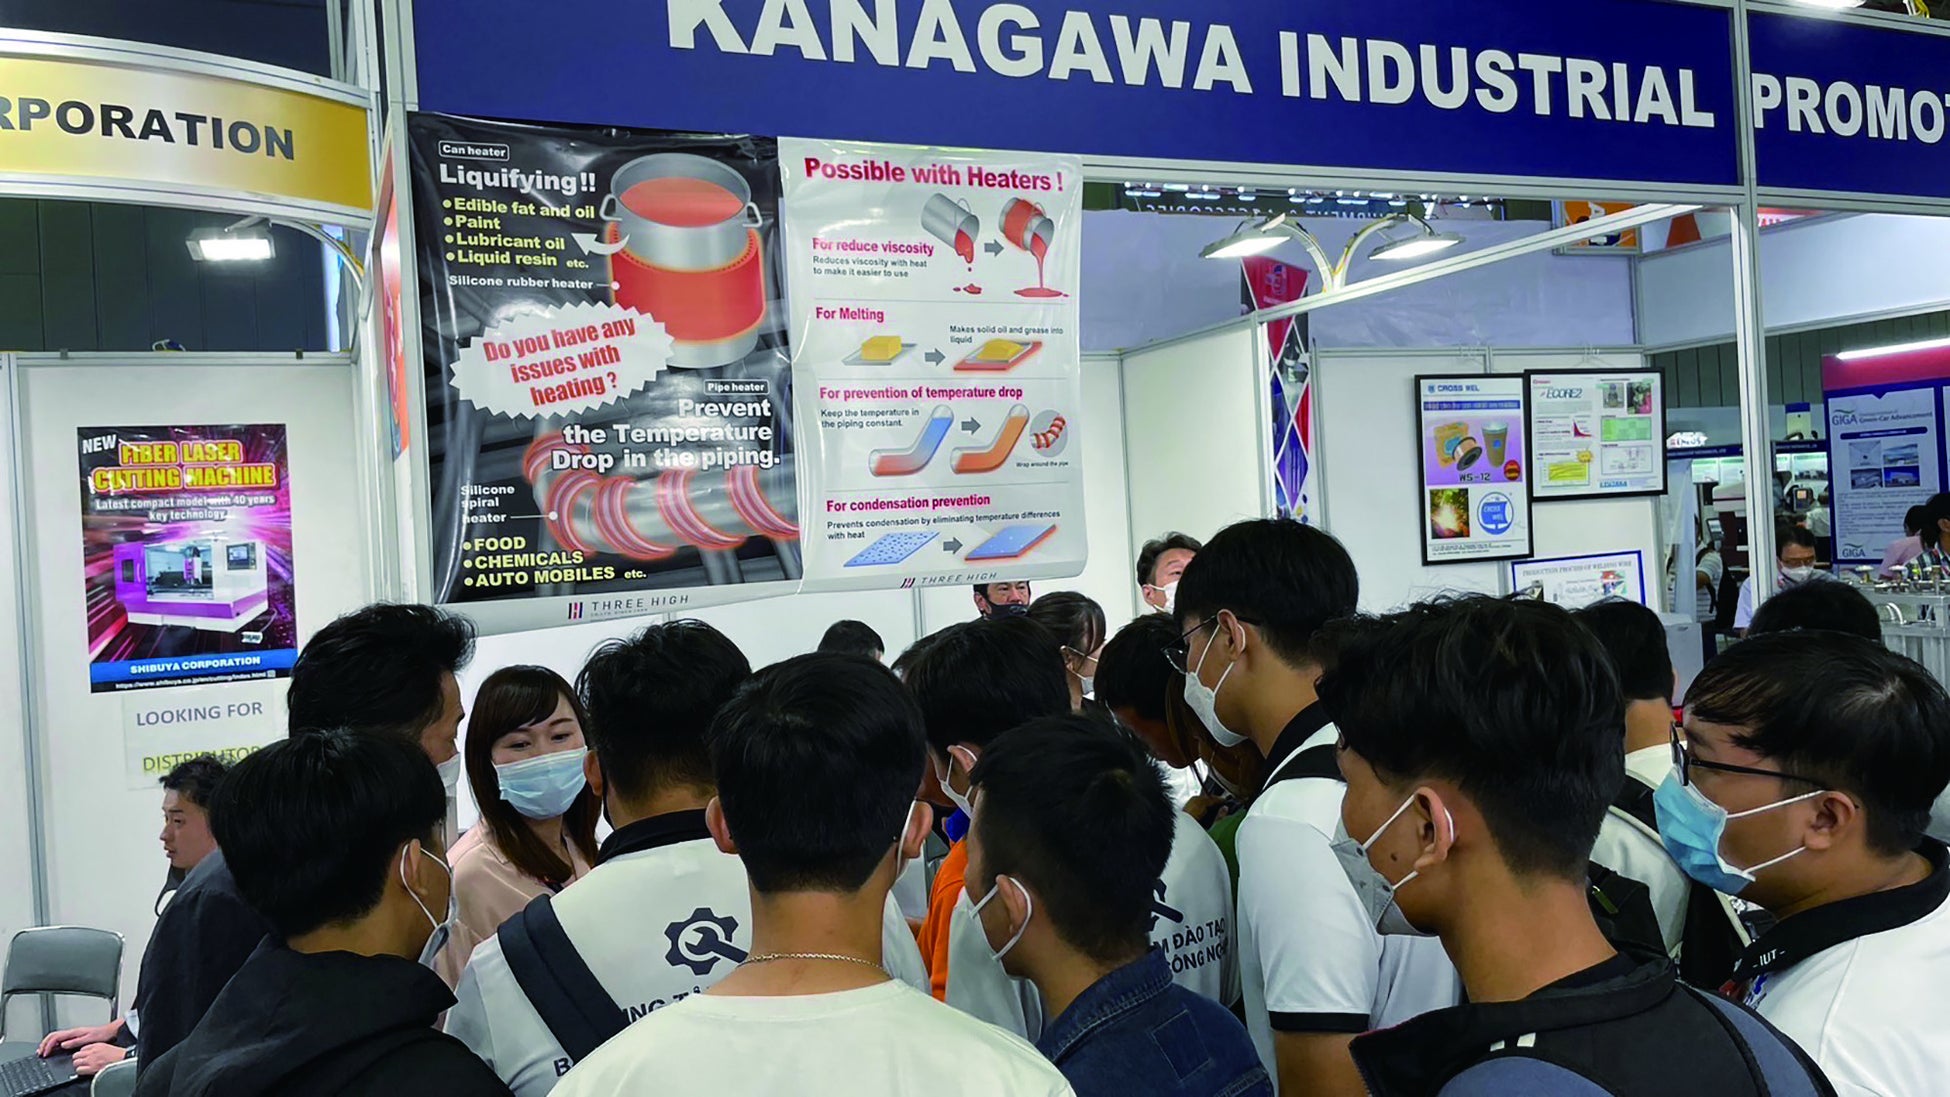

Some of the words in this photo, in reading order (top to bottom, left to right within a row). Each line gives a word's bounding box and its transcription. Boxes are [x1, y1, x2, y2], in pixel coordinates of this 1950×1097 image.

[669, 0, 1253, 94] KANAGAWA
[1279, 31, 1715, 128] INDUSTRIAL
[1752, 73, 1950, 144] PROMO
[443, 144, 465, 155] Can
[467, 145, 506, 158] heater
[805, 157, 906, 183] Possible
[912, 164, 961, 186] with
[454, 198, 507, 213] Edible
[511, 202, 536, 215] fat
[540, 204, 570, 217] and
[575, 204, 595, 219] oil
[455, 215, 500, 229] Paint
[456, 233, 541, 249] Lubricant
[544, 236, 565, 250] oil
[812, 238, 833, 251] For
[836, 240, 878, 252] reduce
[881, 241, 934, 256] viscosity
[457, 250, 511, 266] Liquid
[514, 252, 557, 266] resin
[566, 259, 589, 269] etc.
[813, 256, 849, 265] Reduces
[851, 257, 889, 268] viscosity
[891, 258, 908, 267] with
[910, 260, 927, 268] heat
[813, 267, 822, 276] to
[824, 268, 847, 276] make
[849, 268, 855, 276] it
[856, 269, 882, 277] easier
[883, 269, 892, 277] to
[894, 270, 908, 278] use
[449, 275, 503, 287] Silicone
[507, 277, 549, 288] rubber
[551, 278, 593, 289] heater
[816, 307, 837, 320] For
[840, 307, 884, 323] Melting
[950, 325, 975, 334] Makes
[977, 325, 994, 334] solid
[996, 325, 1007, 334] oil
[1009, 326, 1023, 334] and
[1024, 327, 1049, 336] grease
[1050, 327, 1064, 335] into
[483, 340, 510, 361] Do
[512, 336, 550, 358] you
[554, 326, 599, 349] have
[601, 318, 636, 342] any
[950, 335, 973, 344] liquid
[510, 357, 575, 384] issues
[580, 343, 621, 370] with
[707, 381, 729, 393] Pipe
[730, 381, 765, 391] heater
[820, 387, 841, 399] For
[843, 387, 908, 401] prevention
[912, 387, 923, 399] of
[926, 386, 996, 400] temperature
[998, 386, 1023, 400] drop
[678, 399, 771, 418] Prevent
[821, 408, 842, 419] Keep
[844, 408, 858, 417] the
[860, 408, 909, 418] temperature
[911, 408, 920, 416] in
[821, 420, 835, 429] the
[837, 419, 864, 431] piping
[1832, 415, 1858, 425] GIGA
[563, 425, 607, 444] the
[613, 423, 773, 445] Temperature
[82, 435, 116, 453] NEW
[121, 445, 177, 464] FIBER
[183, 443, 240, 462] LASER
[551, 450, 614, 473] Drop
[623, 450, 645, 468] in
[654, 449, 698, 468] the
[702, 448, 781, 469] piping.
[95, 467, 180, 490] CUTTING
[186, 466, 274, 487] MACHINE
[1460, 473, 1490, 482] WS-12
[460, 485, 515, 496] Silicone
[95, 499, 130, 510] Latest
[131, 498, 175, 509] compact
[177, 497, 207, 507] model
[233, 496, 246, 505] 40
[248, 495, 275, 506] years
[461, 496, 499, 509] spiral
[826, 499, 847, 512] For
[849, 496, 929, 511] condensation
[931, 495, 991, 511] prevention
[149, 512, 168, 522] key
[170, 510, 226, 521] technology
[462, 512, 507, 524] heater
[827, 520, 864, 529] Prevents
[866, 517, 919, 528] condensation
[921, 516, 931, 526] by
[932, 513, 974, 526] eliminating
[975, 513, 1020, 523] temperature
[1021, 510, 1060, 520] differences
[827, 531, 845, 540] with
[847, 530, 865, 539] heat
[475, 537, 526, 551] FOOD
[475, 551, 583, 569] CHEMICALS
[1842, 549, 1865, 557] GIGA
[475, 572, 528, 587] AUTO
[535, 566, 615, 584] MOBILES
[624, 568, 646, 580] etc.
[921, 573, 963, 584] THREE
[966, 572, 997, 581] HIGH
[592, 599, 644, 611] THREE
[651, 595, 688, 606] HIGH
[130, 663, 179, 674] SHIBUYA
[181, 656, 261, 670] CORPORATION
[136, 706, 220, 726] LOOKING
[227, 702, 263, 717] FOR
[1173, 925, 1204, 949] ĐÀO
